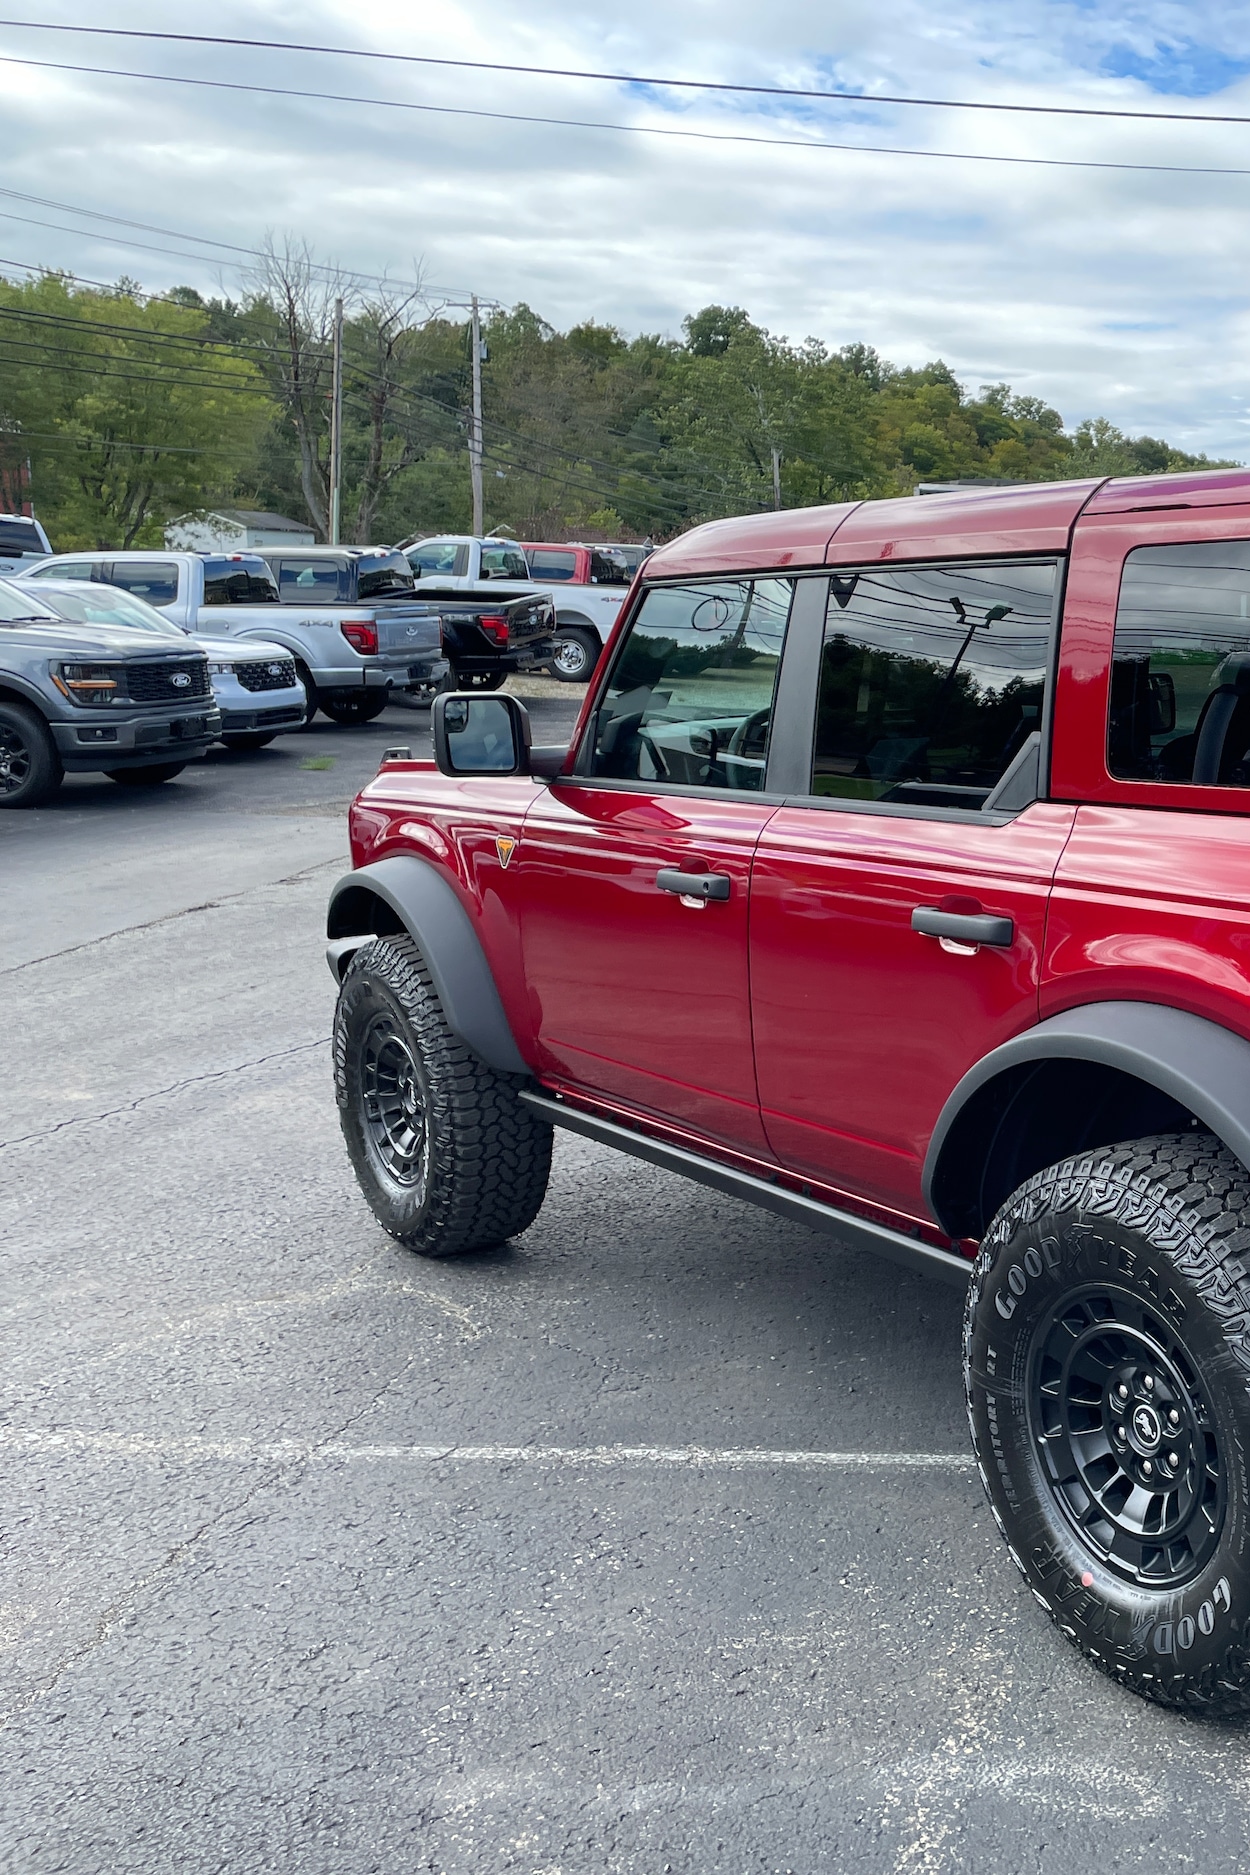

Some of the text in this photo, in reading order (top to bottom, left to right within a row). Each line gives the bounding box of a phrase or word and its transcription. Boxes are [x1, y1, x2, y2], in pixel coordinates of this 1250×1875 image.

[994, 1223, 1188, 1327] GOODYEAR
[986, 1344, 1021, 1515] TERRITORY RT
[1031, 1540, 1232, 1661] GOODYEAR
